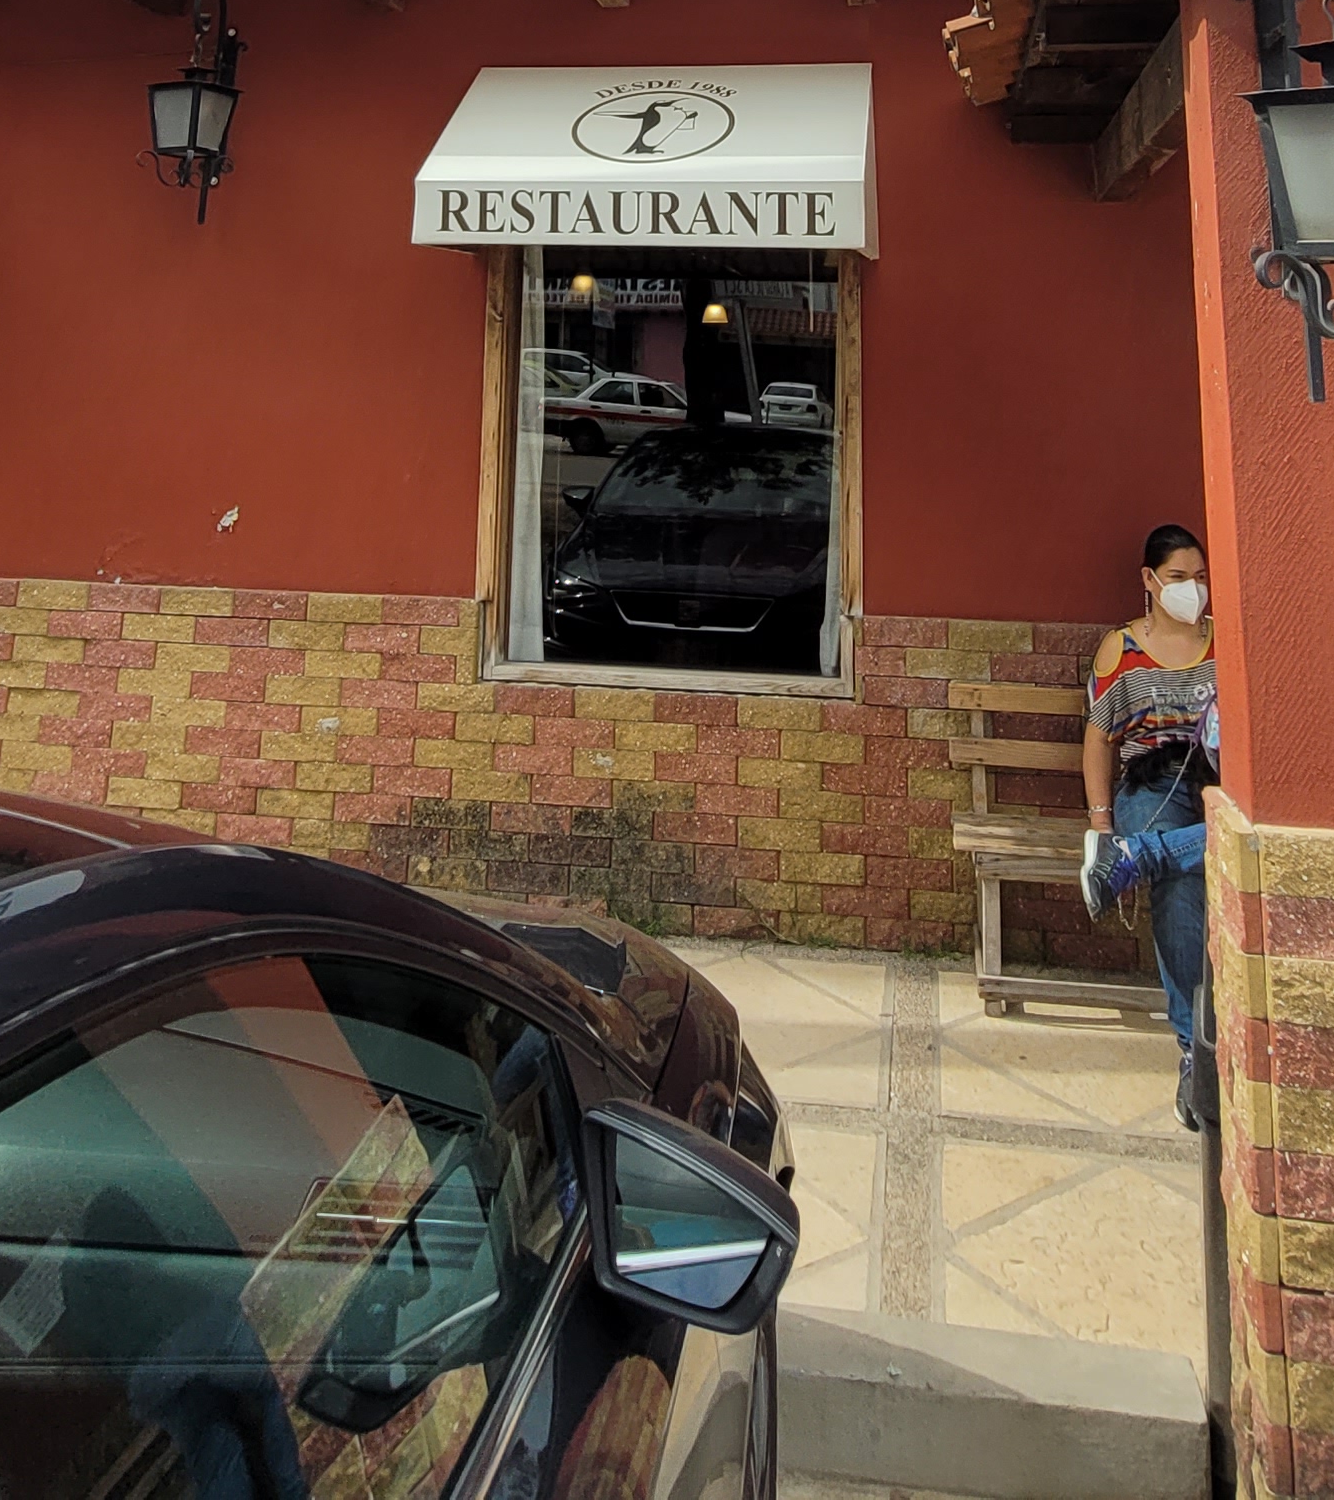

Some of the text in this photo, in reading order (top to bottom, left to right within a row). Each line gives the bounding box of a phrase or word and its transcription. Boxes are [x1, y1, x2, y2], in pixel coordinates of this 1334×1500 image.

[594, 79, 737, 98] DESDE 1988
[436, 188, 836, 237] RESTAURANTE
